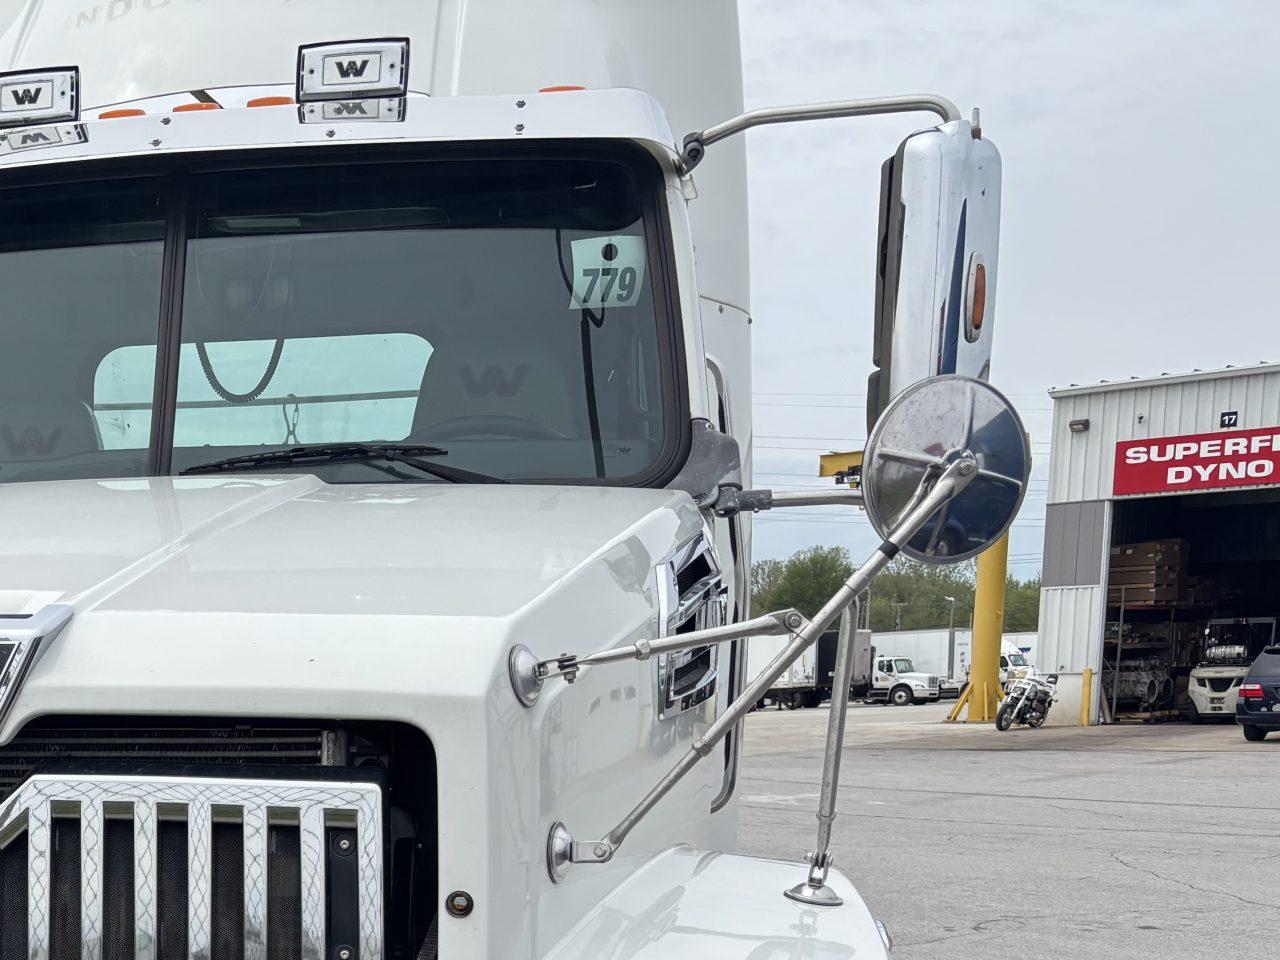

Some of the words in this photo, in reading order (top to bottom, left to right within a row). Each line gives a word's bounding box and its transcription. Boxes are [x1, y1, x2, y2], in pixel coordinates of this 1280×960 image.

[335, 60, 369, 78] W
[11, 87, 42, 105] W
[582, 266, 637, 303] 779
[1222, 415, 1237, 425] 17
[1166, 459, 1274, 484] DYNO
